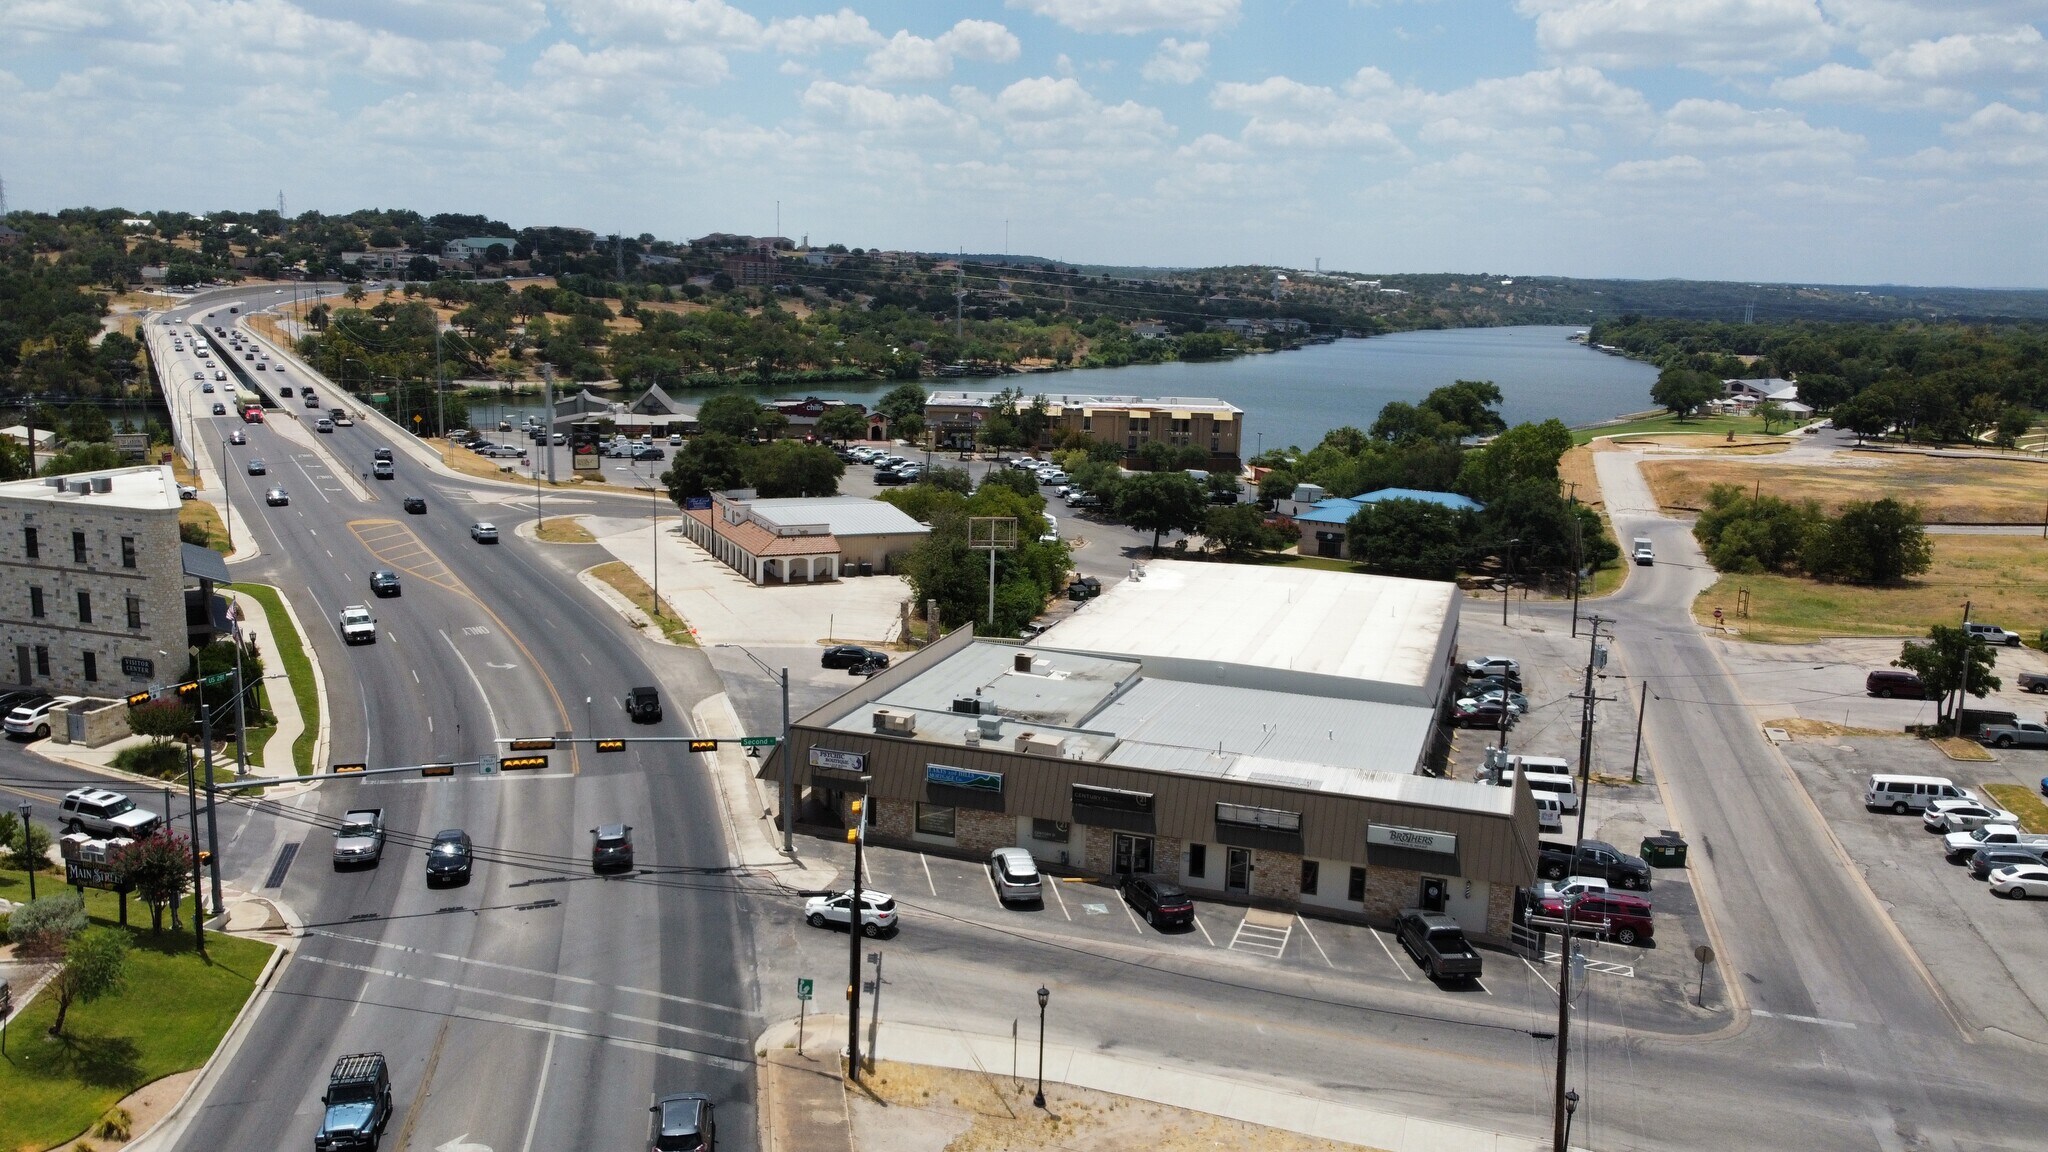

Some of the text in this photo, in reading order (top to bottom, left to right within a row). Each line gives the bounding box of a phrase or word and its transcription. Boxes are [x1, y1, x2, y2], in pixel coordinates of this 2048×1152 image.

[462, 625, 490, 636] ONLY
[125, 658, 150, 668] VISITOR
[126, 665, 150, 674] CENTER
[216, 674, 226, 682] 281
[819, 751, 845, 760] PSYCHIC
[1074, 792, 1101, 801] CENTURY
[1389, 830, 1434, 845] BROTHERS
